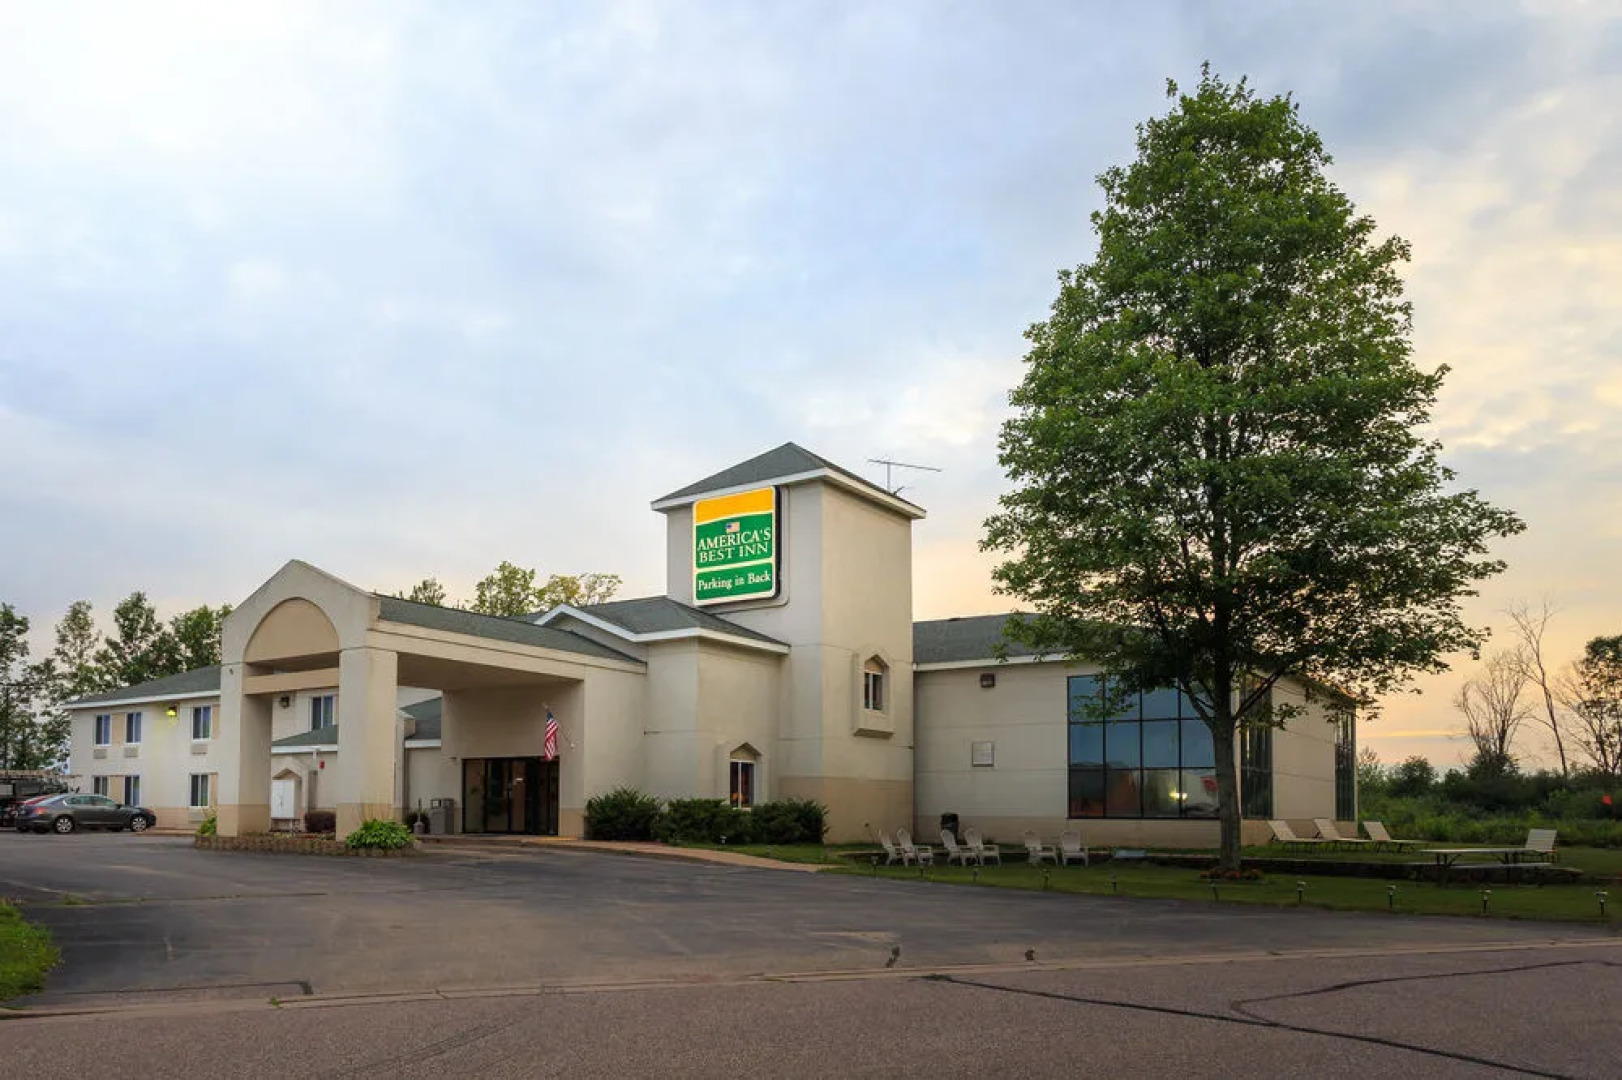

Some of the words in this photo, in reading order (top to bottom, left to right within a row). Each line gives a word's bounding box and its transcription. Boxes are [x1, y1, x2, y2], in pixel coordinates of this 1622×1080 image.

[697, 527, 771, 551] AMERICA'S
[700, 547, 735, 563] BEST
[739, 541, 768, 557] INN
[698, 577, 732, 590] Parking
[735, 575, 745, 586] in
[747, 570, 771, 585] Back
